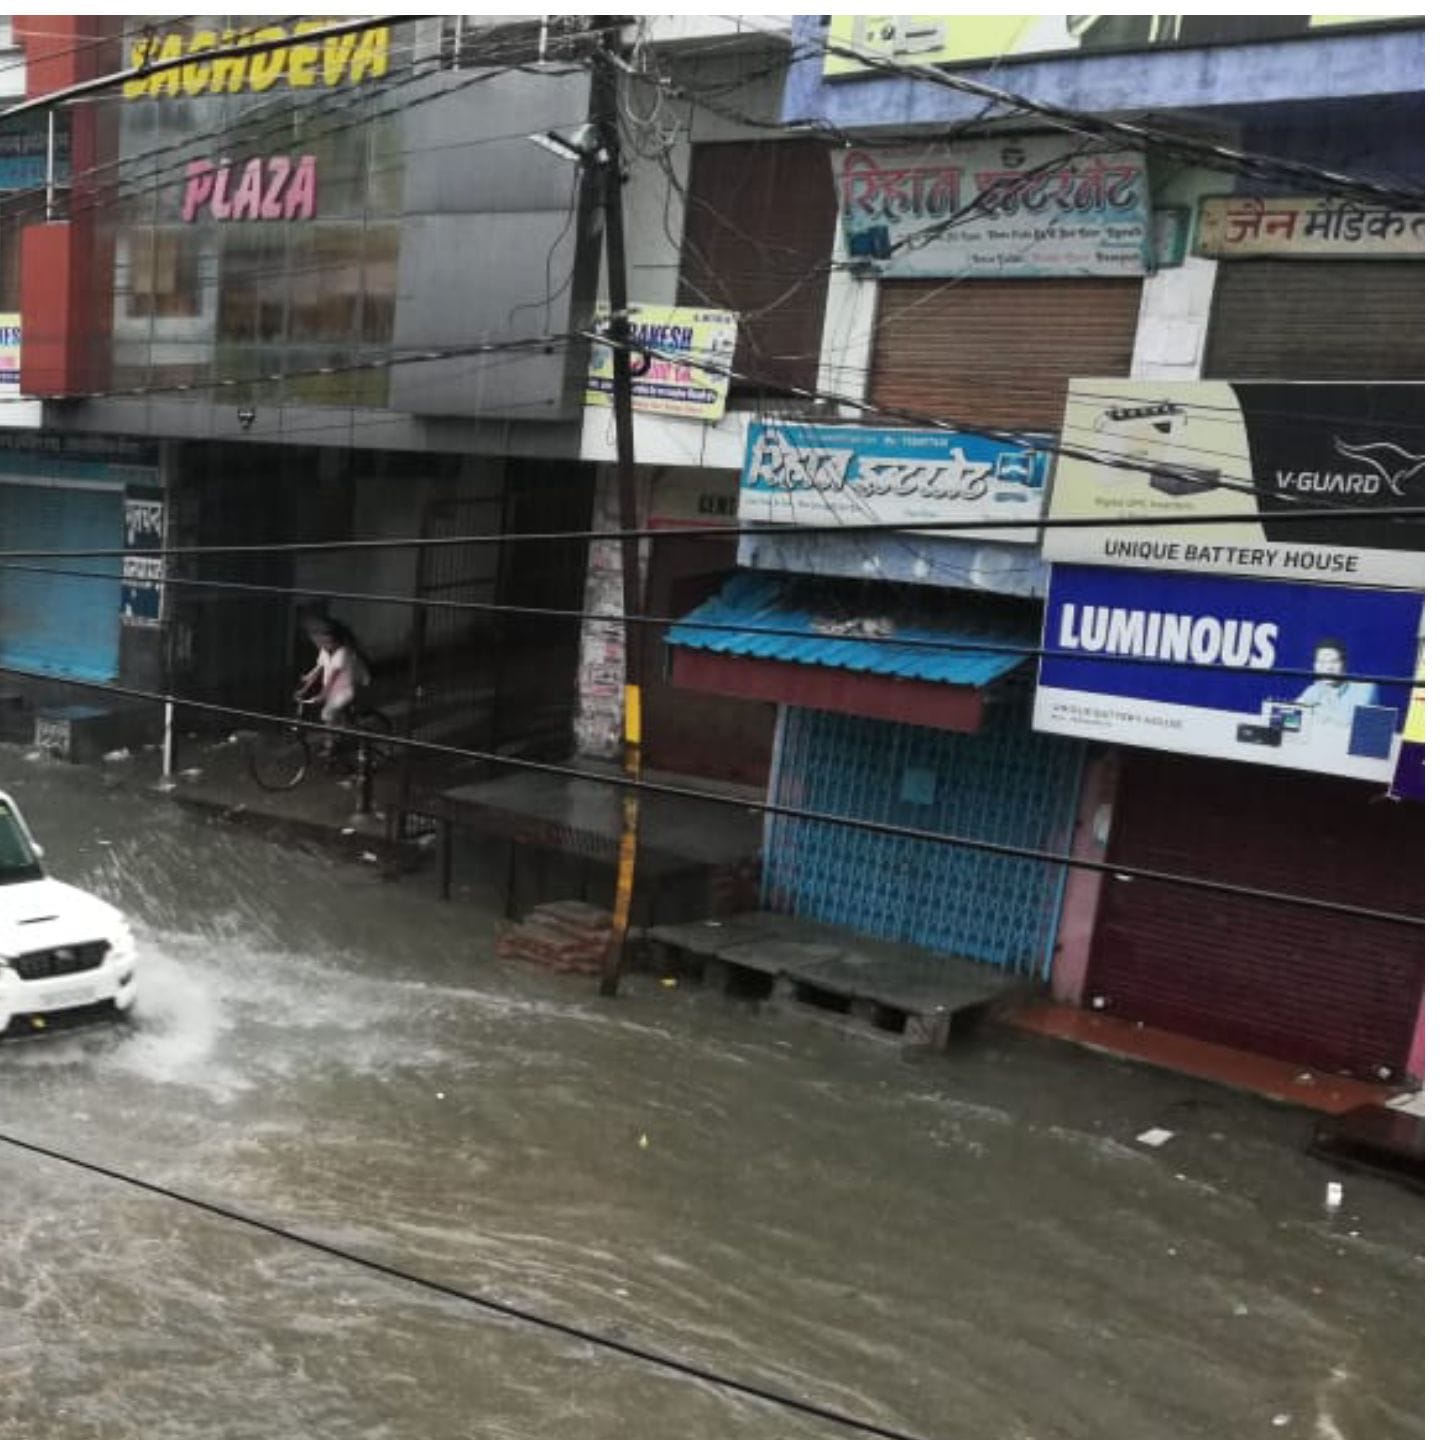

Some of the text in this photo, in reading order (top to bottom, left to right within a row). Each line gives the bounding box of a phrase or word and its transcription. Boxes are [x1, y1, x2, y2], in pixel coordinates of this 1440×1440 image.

[122, 21, 390, 99] SACHDEVA
[180, 154, 317, 222] PLAZA
[1224, 198, 1301, 244] जैन
[1275, 469, 1380, 495] V-GUARD
[1104, 538, 1360, 573] UNIQUE BATTERY HOUSE
[1059, 602, 1280, 670] LUMINOUS
